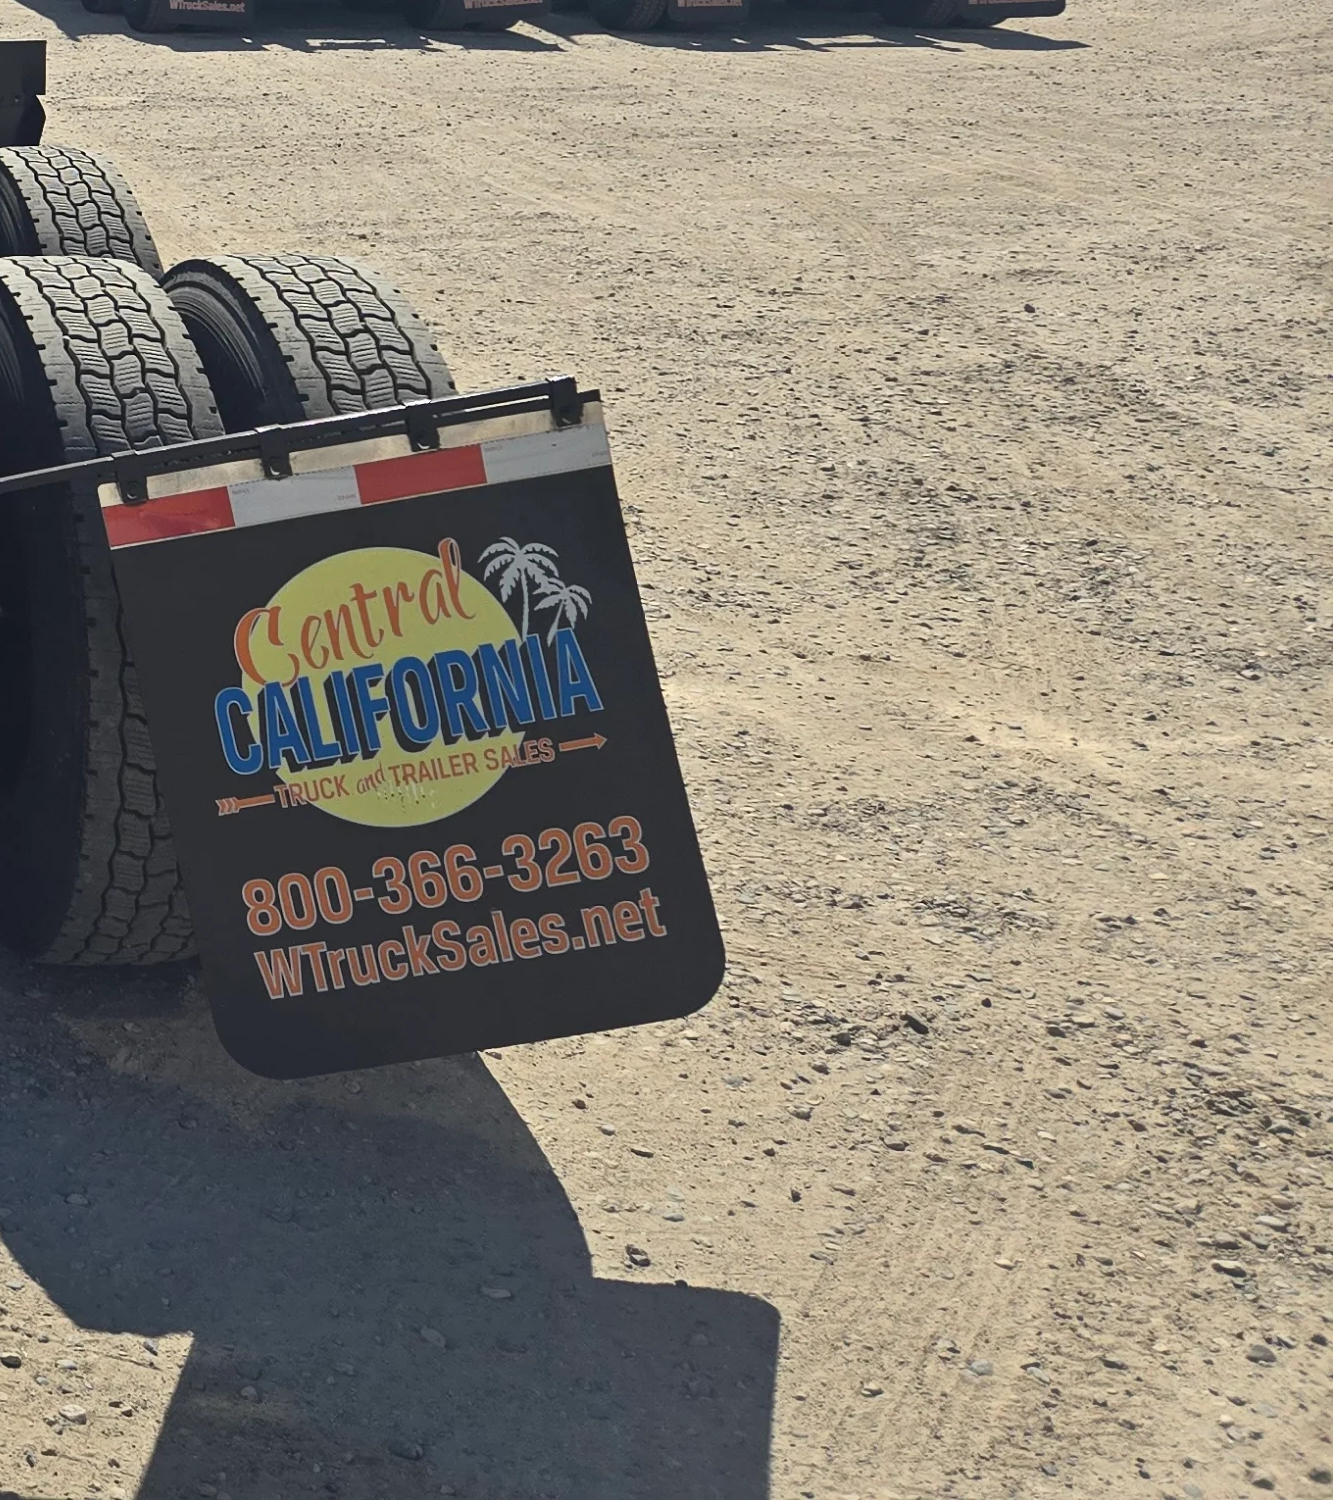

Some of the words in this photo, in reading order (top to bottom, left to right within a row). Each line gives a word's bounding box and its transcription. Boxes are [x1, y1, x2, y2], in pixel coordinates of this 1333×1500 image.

[234, 537, 476, 687] Central
[214, 627, 604, 776] CALIFORNIA
[273, 773, 351, 809] TRUCK
[356, 761, 386, 795] and
[389, 752, 479, 787] TRAILER
[485, 737, 556, 772] SALES
[241, 815, 650, 937] 800-366-3263
[253, 887, 668, 1000] WTruckSales.net
